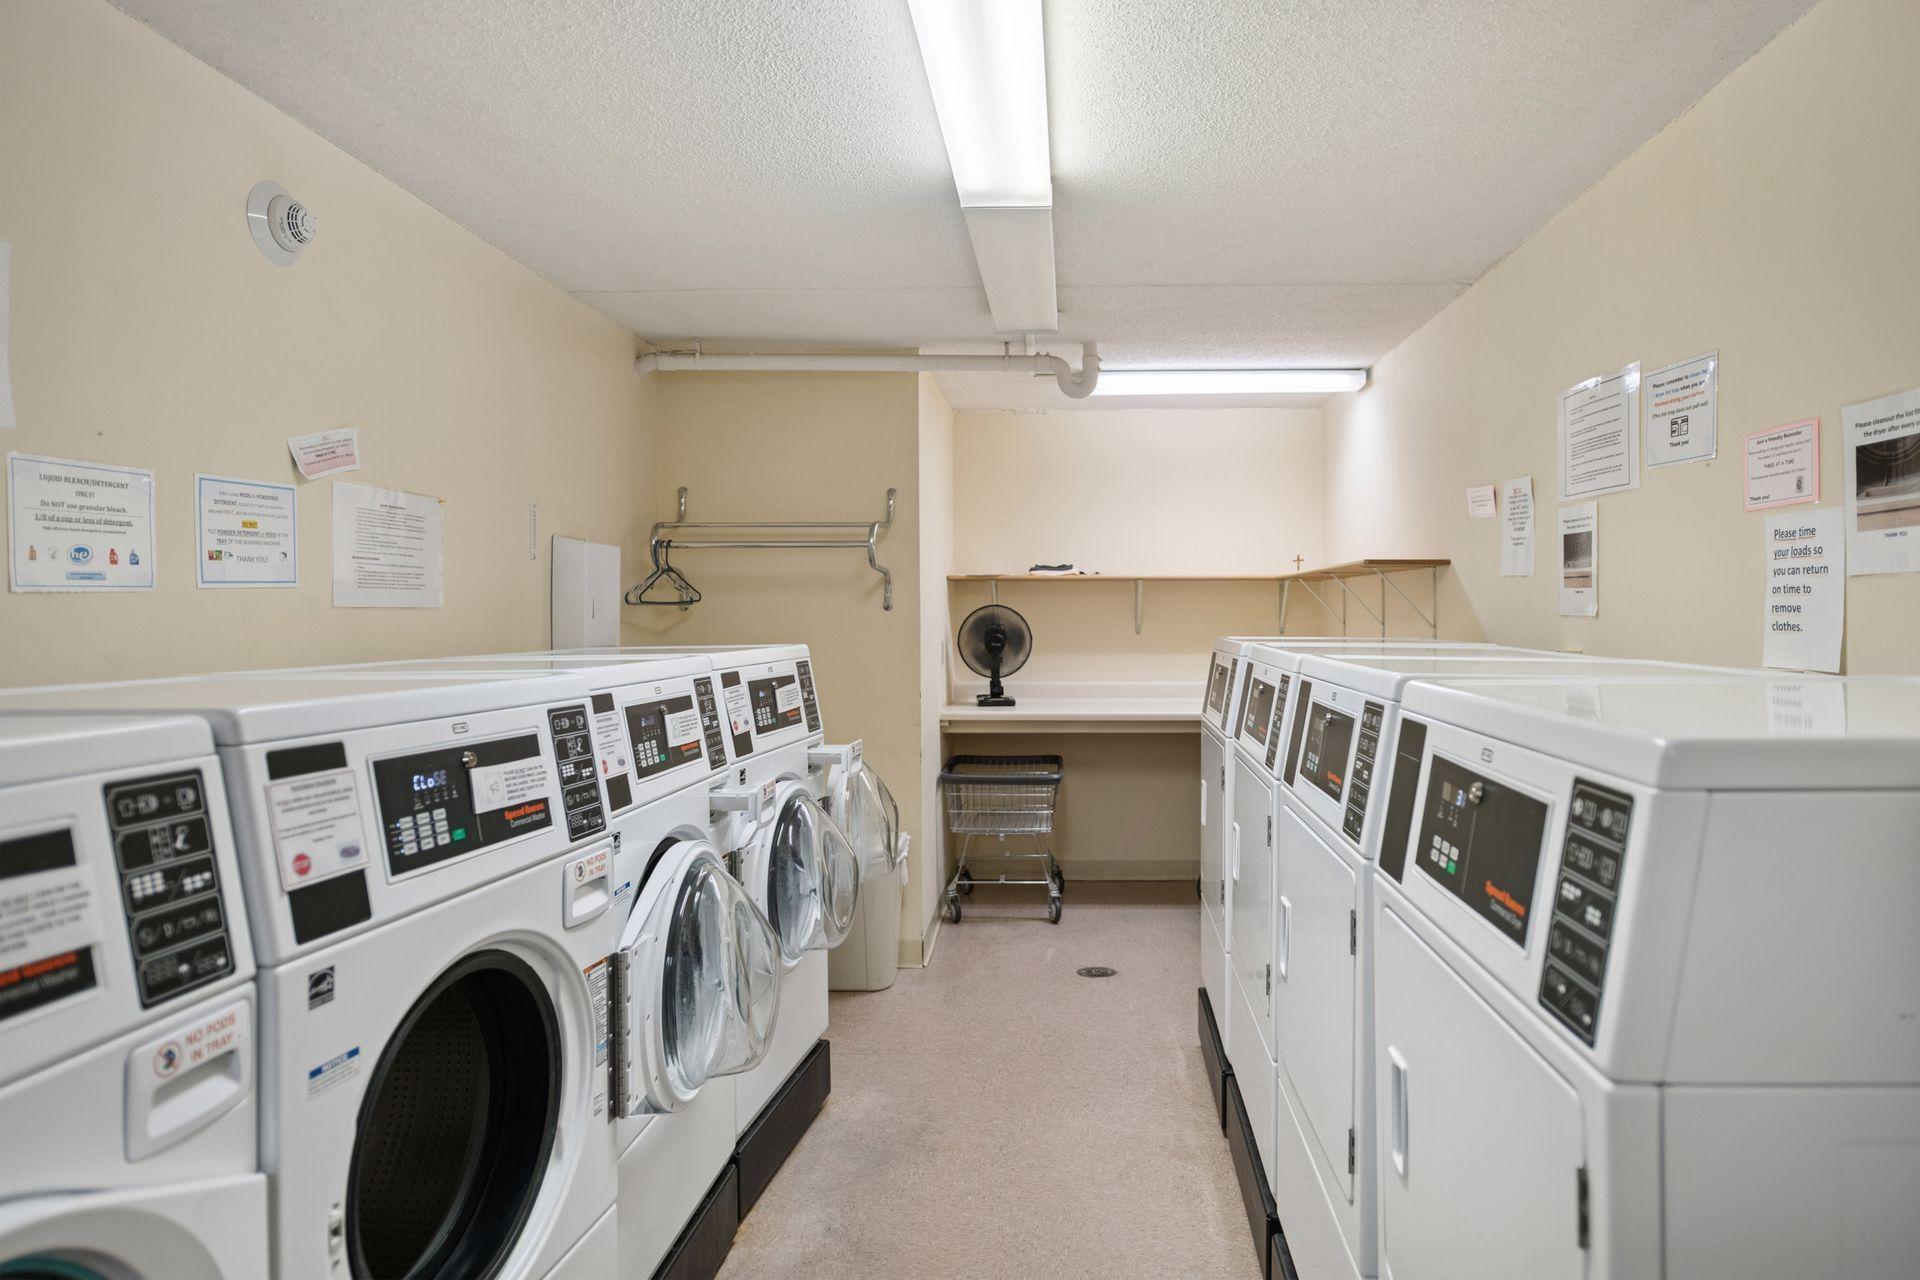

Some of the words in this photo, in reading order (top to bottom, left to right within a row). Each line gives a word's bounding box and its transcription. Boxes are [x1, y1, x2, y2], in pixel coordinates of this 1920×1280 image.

[1873, 416, 1894, 425] cleanout
[39, 474, 62, 483] LIQUID
[64, 476, 129, 489] BLEACH/DETERGENT
[1774, 529, 1796, 539] Please
[1799, 526, 1816, 538] time
[1774, 548, 1789, 558] your
[1791, 546, 1811, 556] loads
[1813, 546, 1823, 555] so
[1773, 567, 1786, 578] you
[1787, 567, 1800, 575] can
[1802, 564, 1828, 575] return
[1772, 586, 1781, 594] on
[1783, 584, 1800, 594] time
[1802, 584, 1811, 594] to
[1772, 604, 1801, 613] remove
[1772, 622, 1802, 632] clothes.
[504, 807, 524, 820] Speed
[186, 1029, 203, 1046] NO
[206, 1014, 236, 1034] PODS
[191, 1048, 204, 1064] IN
